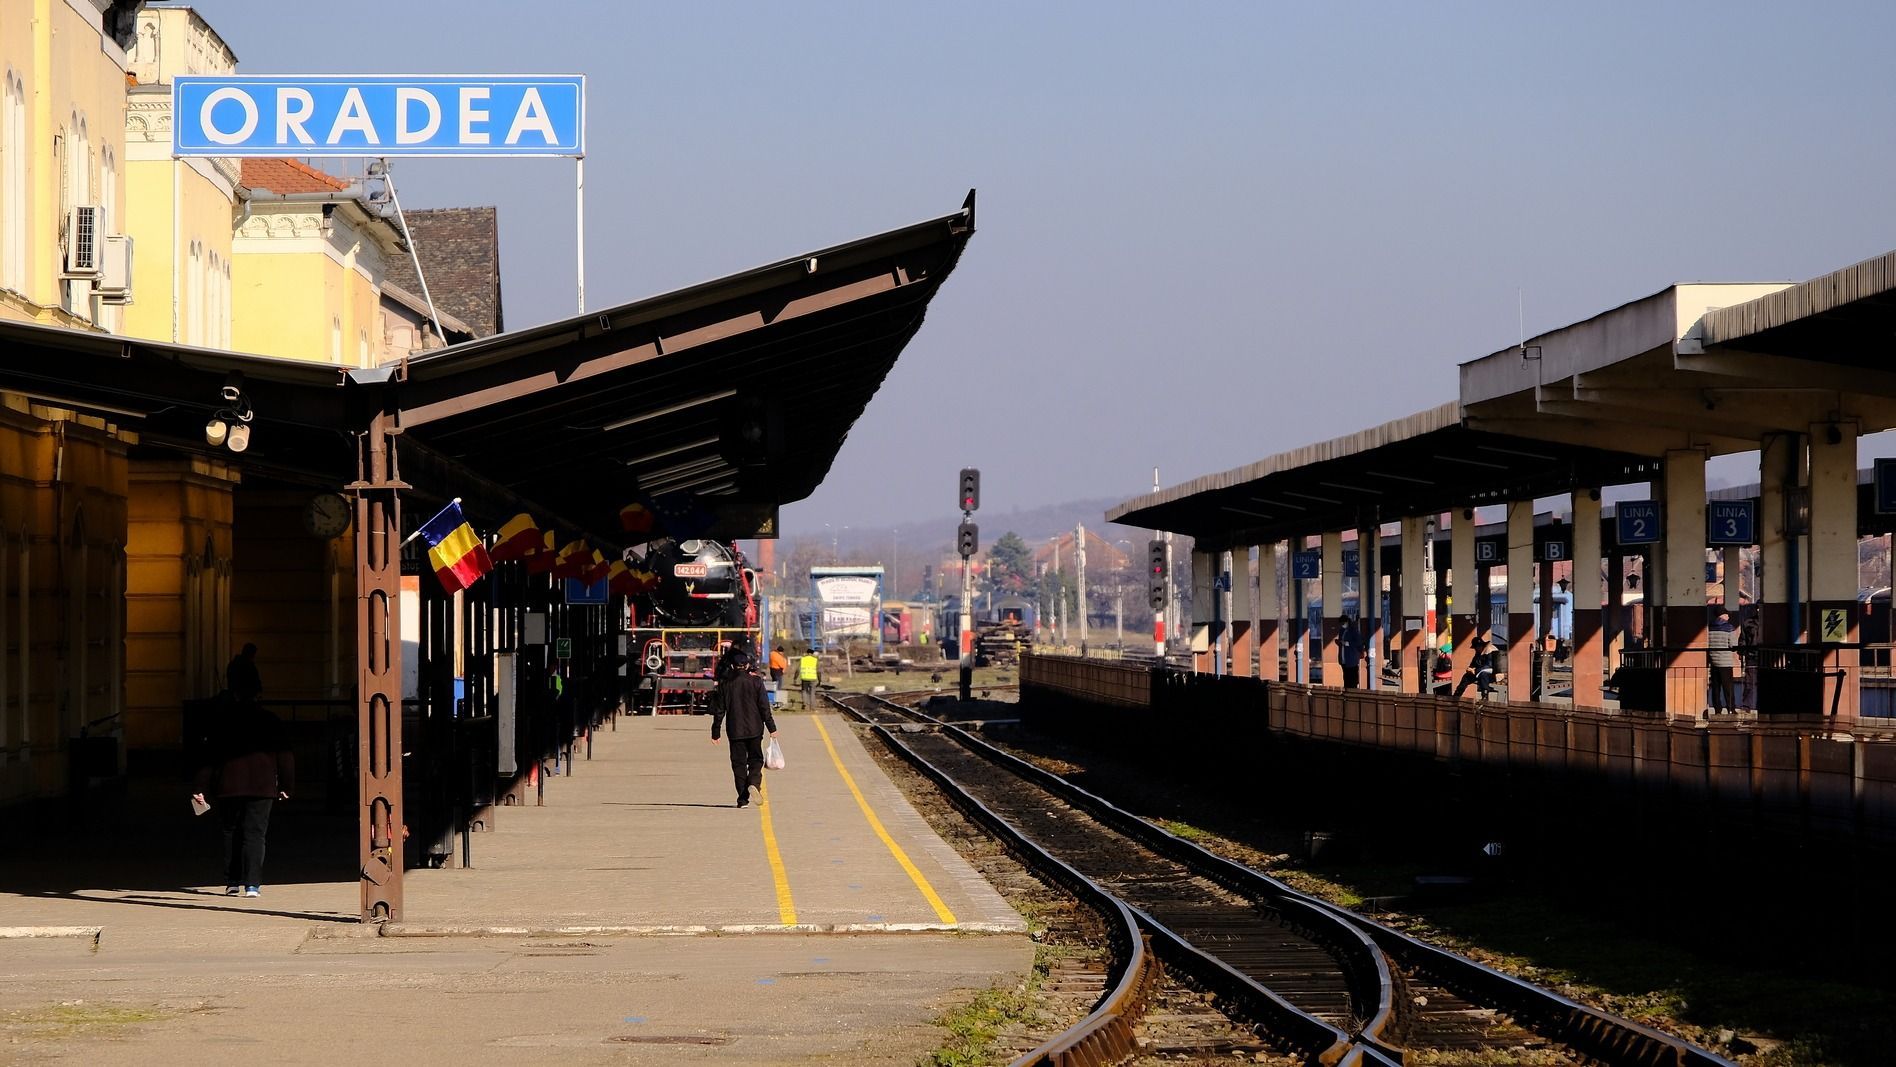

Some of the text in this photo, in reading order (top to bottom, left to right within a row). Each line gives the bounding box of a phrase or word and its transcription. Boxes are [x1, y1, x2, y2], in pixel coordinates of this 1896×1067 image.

[200, 87, 559, 145] ORADEA
[1624, 507, 1654, 518] LINIA
[1716, 507, 1747, 518] LINIA
[1633, 519, 1646, 537] 2
[1725, 519, 1737, 537] 3
[1482, 545, 1493, 559] B
[1549, 543, 1560, 558] B
[1301, 564, 1310, 575] 2
[1215, 578, 1224, 588] A
